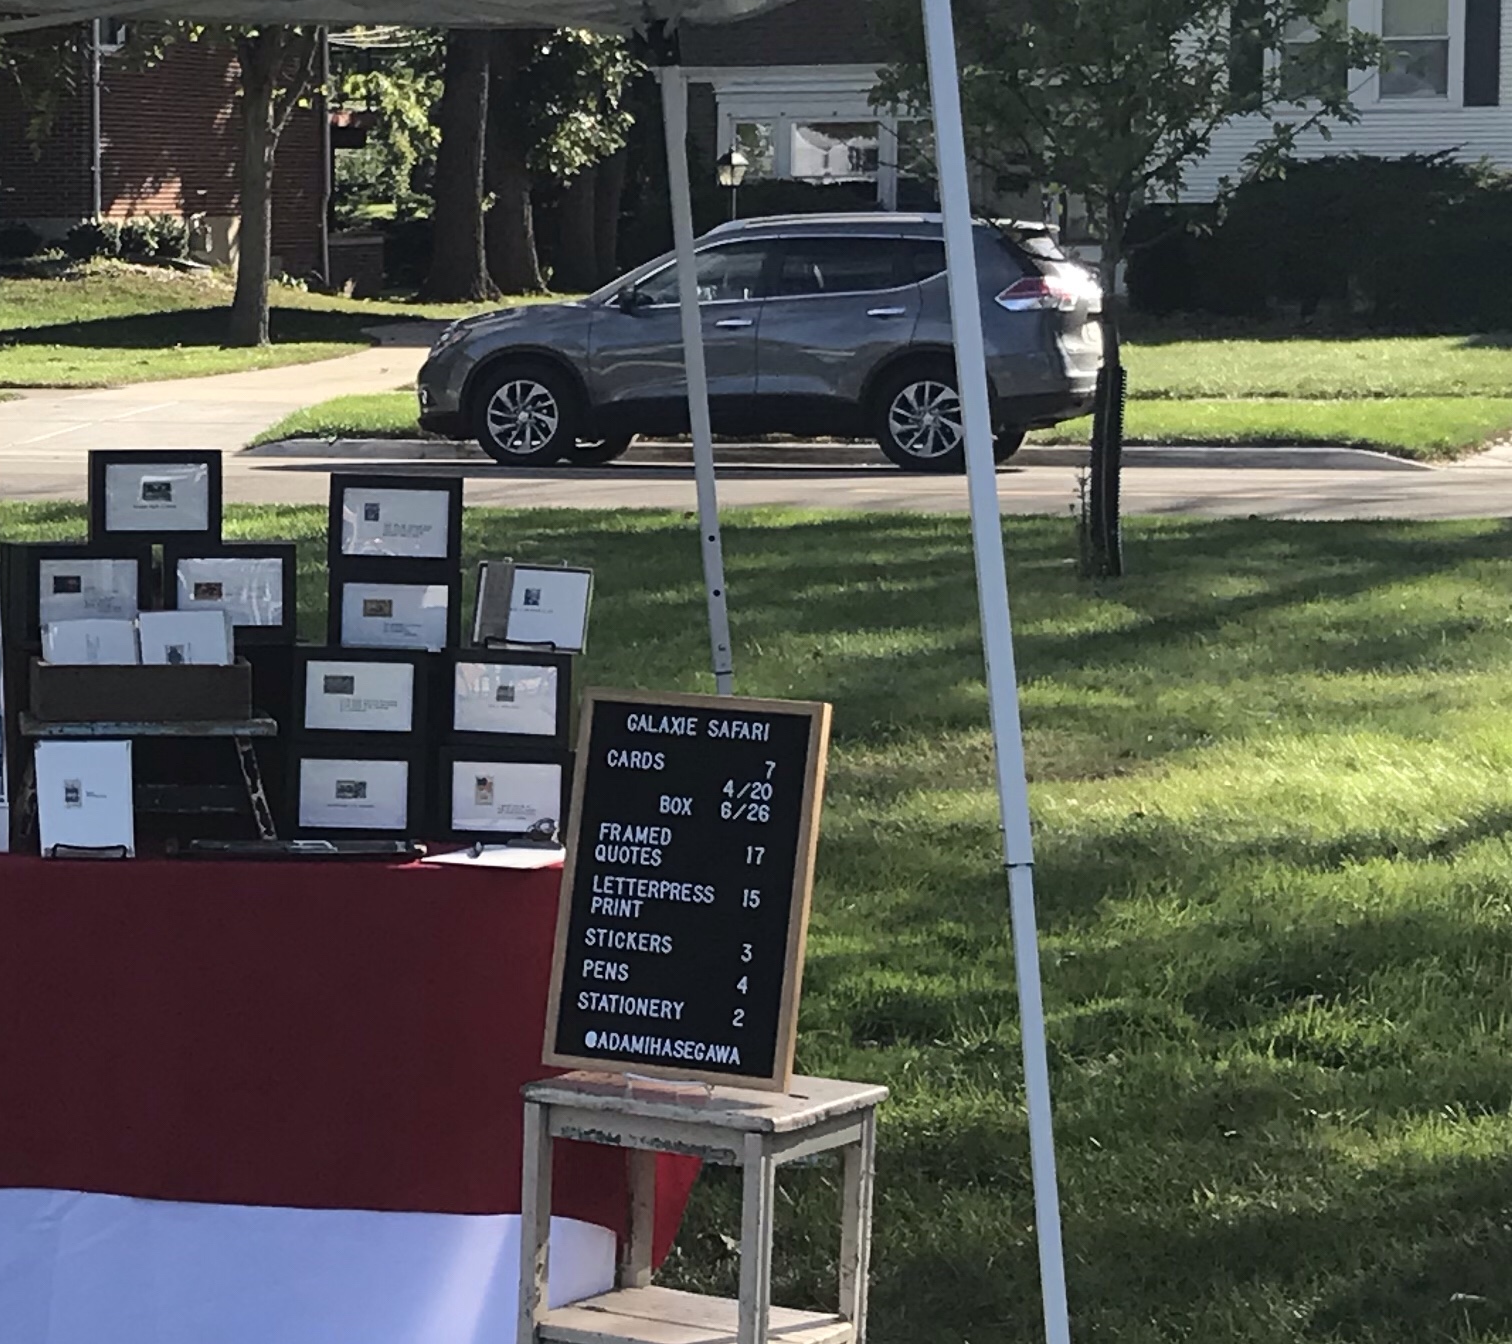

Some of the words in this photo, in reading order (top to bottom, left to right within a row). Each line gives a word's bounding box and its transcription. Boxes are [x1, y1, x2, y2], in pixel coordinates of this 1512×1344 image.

[627, 713, 699, 736] GALAXIE
[707, 719, 770, 742] SAFARI
[607, 749, 665, 771] CARDS
[765, 760, 776, 780] 7
[722, 779, 773, 801] 4/20
[659, 794, 693, 816] BOX
[720, 801, 771, 823] 6/26
[599, 822, 672, 846] FRAMED
[594, 844, 662, 867] QUOTES
[746, 845, 765, 865] 17
[592, 874, 715, 904] LETTERPRESS
[742, 888, 761, 909] 15
[590, 896, 644, 918] PRINT
[584, 927, 673, 954] STICKERS
[740, 943, 752, 963] 3
[582, 958, 629, 982] PENS
[736, 975, 748, 995] 4
[577, 991, 685, 1020] STATIONERY
[732, 1008, 745, 1027] 2
[584, 1030, 741, 1066] @ADAMIHASEGAWA
